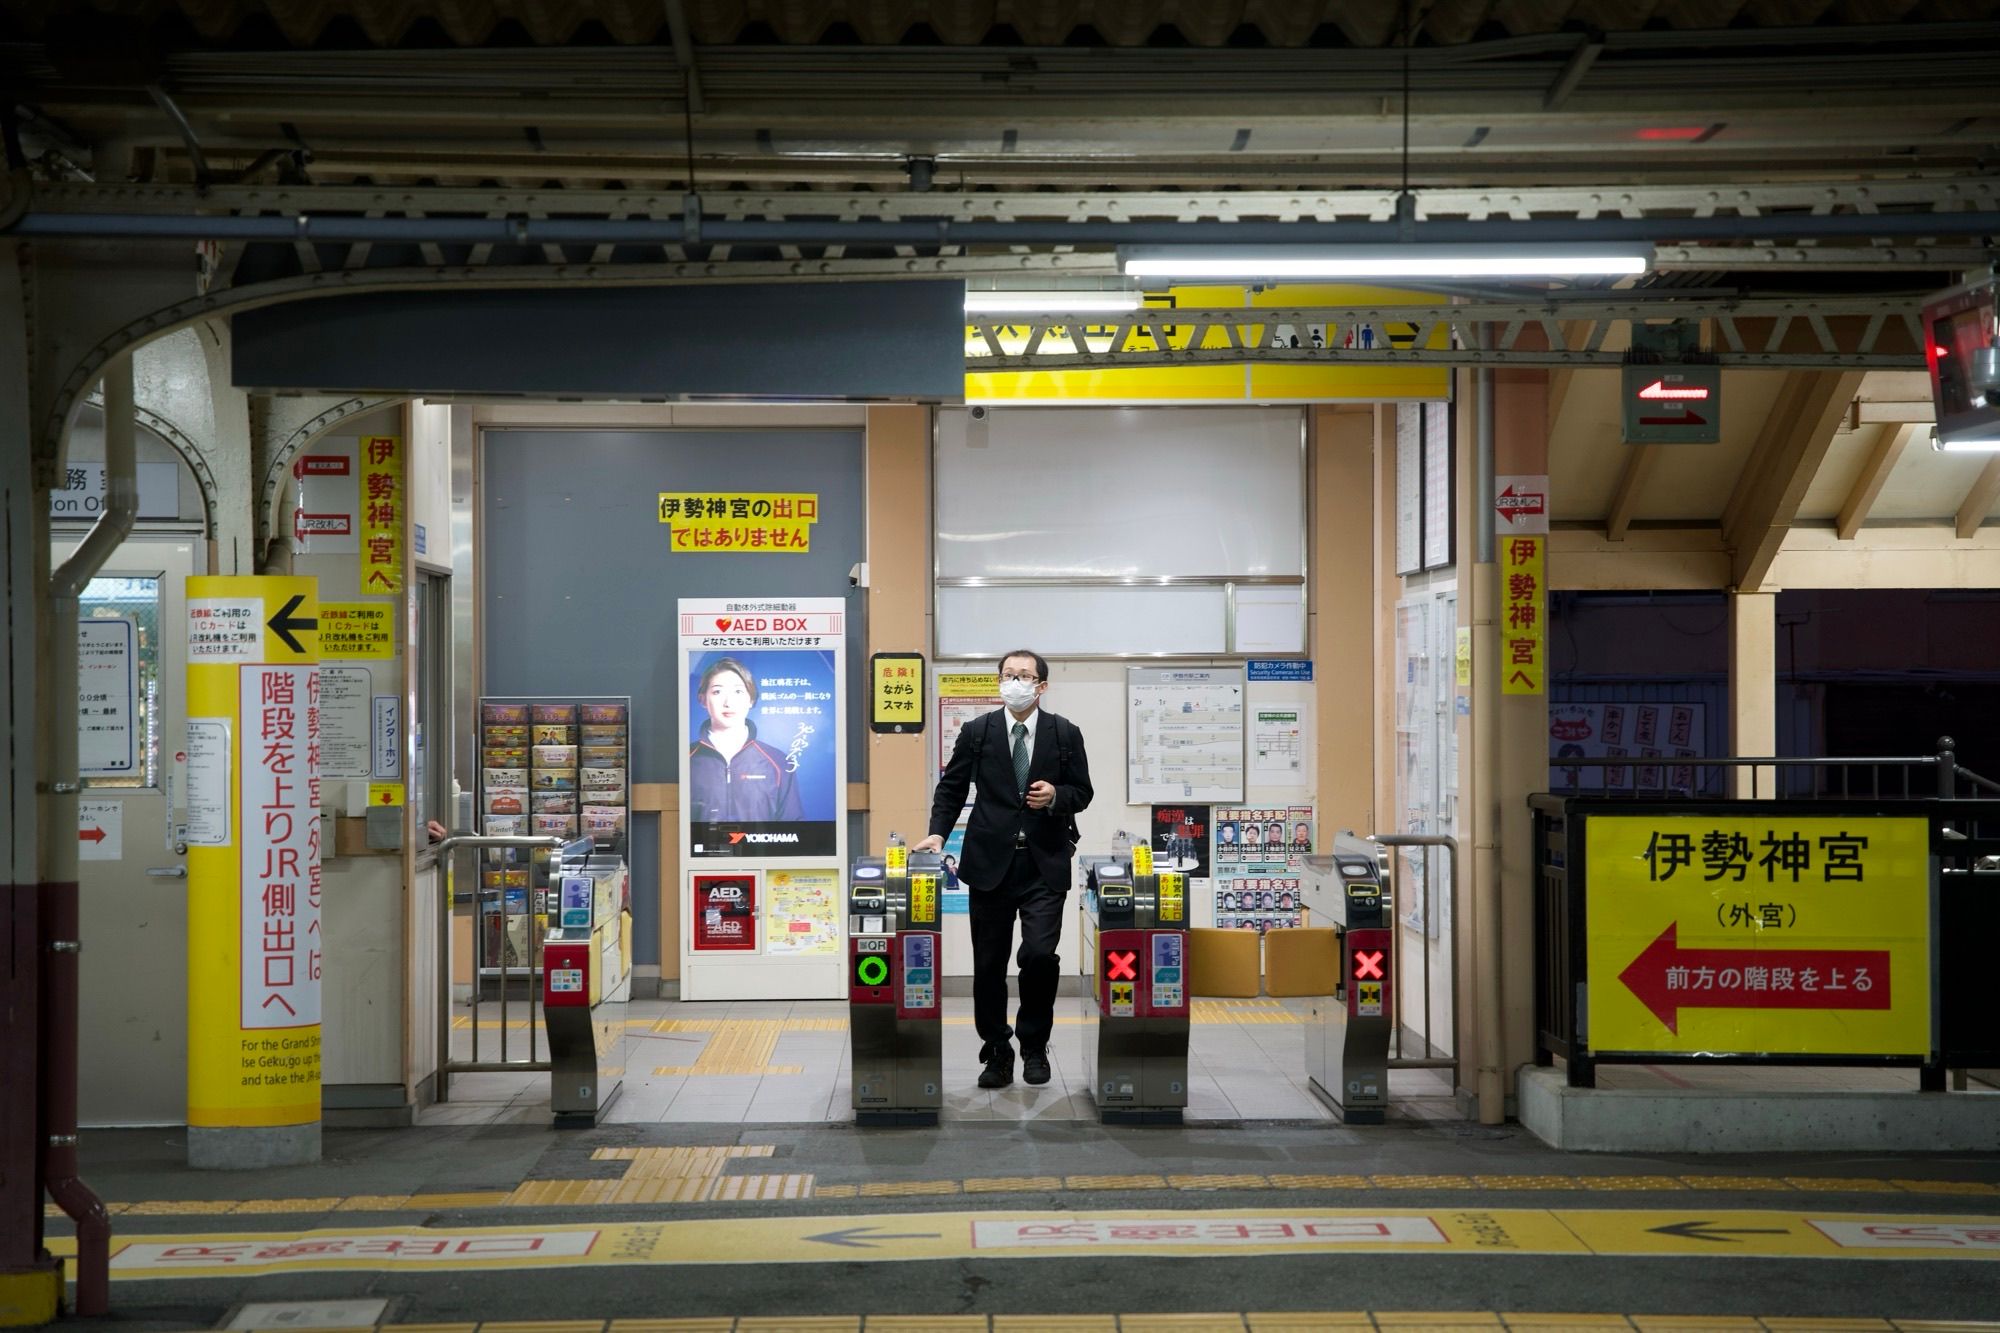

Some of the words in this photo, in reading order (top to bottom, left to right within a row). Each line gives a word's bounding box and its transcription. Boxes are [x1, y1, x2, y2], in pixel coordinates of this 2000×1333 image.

[368, 438, 395, 589] 伊勢神宮へ
[660, 497, 816, 519] 伊勢神宮の出口
[672, 527, 808, 547] ではありません
[726, 603, 796, 612] 自動体外式除細動器
[321, 610, 384, 620] 近鉄線ご利用の
[1509, 540, 1537, 689] 伊勢神宮へ
[733, 619, 767, 631] AED
[773, 618, 808, 631] BOX
[702, 637, 821, 646] どなたでもご利用いただけます
[884, 684, 914, 695] ながら
[884, 700, 914, 711] スマホ
[385, 707, 396, 768] インターホン
[259, 671, 300, 1017] 階段を上りJR側出口へ
[745, 834, 799, 843] YOKOHAMA
[1643, 830, 1868, 883] 伊勢神宮
[1233, 879, 1300, 891] 重要指名手
[709, 888, 741, 898] AED
[1717, 903, 1797, 929] （外宮）
[868, 940, 887, 951] QR
[1665, 966, 1874, 992] 前方の階段を上る
[241, 1040, 258, 1051] For
[262, 1038, 278, 1051] the
[282, 1036, 309, 1049] Grand
[242, 1057, 256, 1068] Ise
[241, 1074, 261, 1085] and
[265, 1073, 287, 1085] take
[290, 1071, 305, 1083] the
